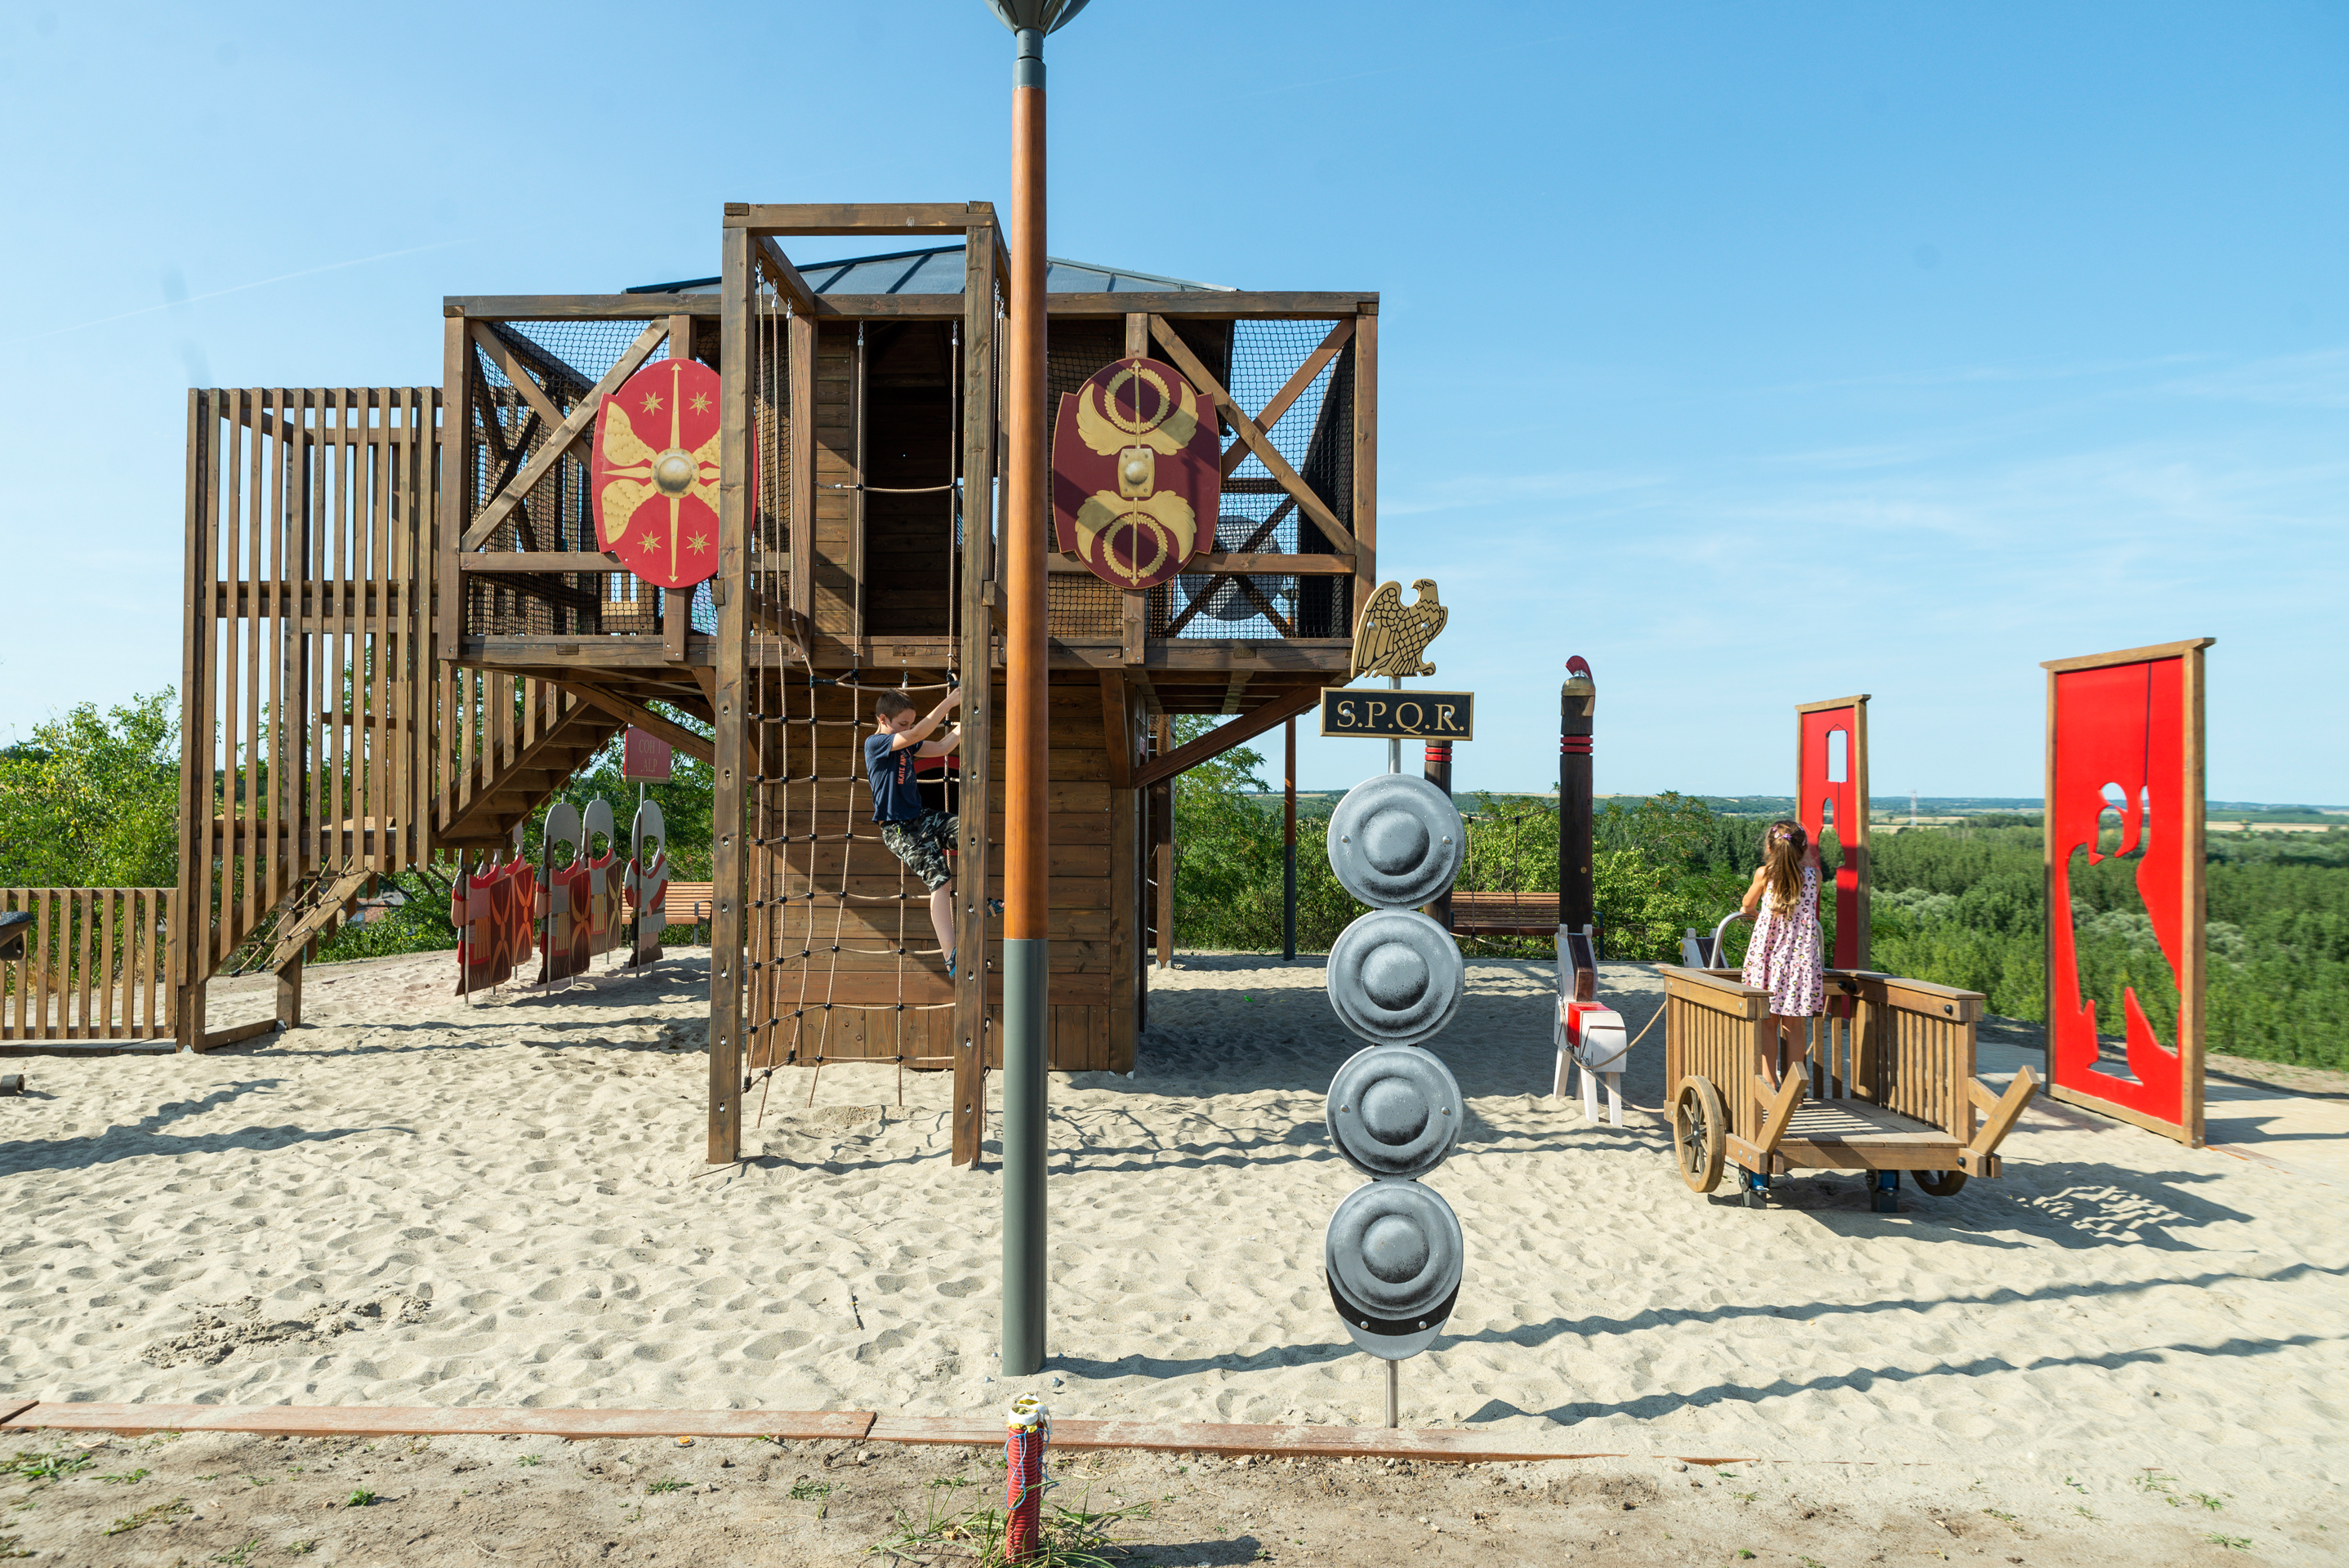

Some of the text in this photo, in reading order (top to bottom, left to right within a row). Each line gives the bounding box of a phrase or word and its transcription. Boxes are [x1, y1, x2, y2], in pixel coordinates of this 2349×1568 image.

[1337, 700, 1464, 735] S.P.Q.R.
[639, 739, 655, 754] COH
[643, 758, 657, 772] ALP
[898, 767, 906, 785] SKATE
